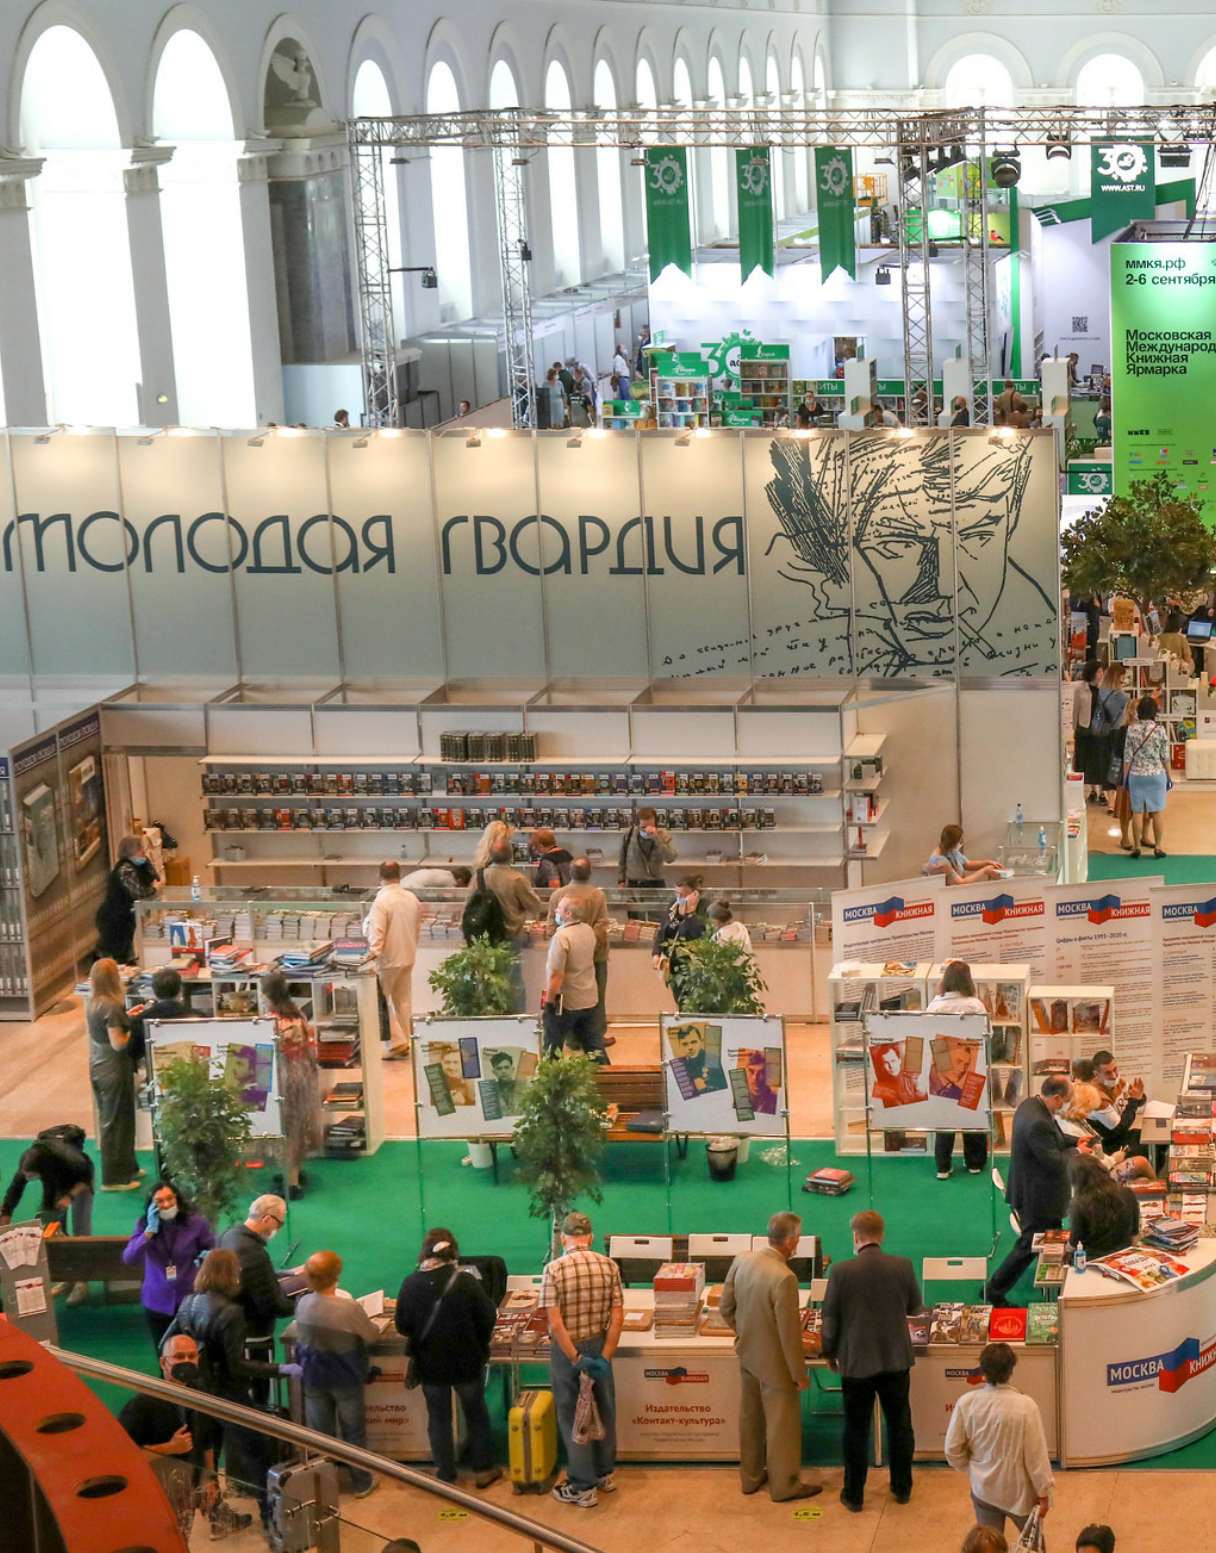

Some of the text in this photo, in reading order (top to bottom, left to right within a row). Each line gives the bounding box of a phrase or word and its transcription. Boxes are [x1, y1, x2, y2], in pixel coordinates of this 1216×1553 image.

[1101, 184, 1146, 192] WWW.AST.RU
[1125, 257, 1186, 271] ммкя.рф
[1125, 273, 1216, 286] 2-6 сентября
[1126, 329, 1211, 341] Московская
[1126, 352, 1189, 364] Книжная
[1126, 363, 1187, 377] Ярмарка
[3, 510, 746, 576] МОЛОДАЯ ГВАРДИЯ
[844, 906, 878, 920] МОСКВА
[895, 905, 933, 919] КНИЖНАЯ
[952, 902, 986, 915] МОСКВА
[1004, 903, 1043, 916] КНИЖНАЯ
[1057, 902, 1092, 914] МОСКВА
[1110, 905, 1150, 917] КНИЖНАЯ
[1164, 905, 1199, 916] МОСКВА
[946, 1369, 969, 1377] МОСКВА
[1110, 1358, 1165, 1382] МОСКВА
[645, 1404, 711, 1413] Издательство
[631, 1416, 726, 1427] «Контакт-культура»
